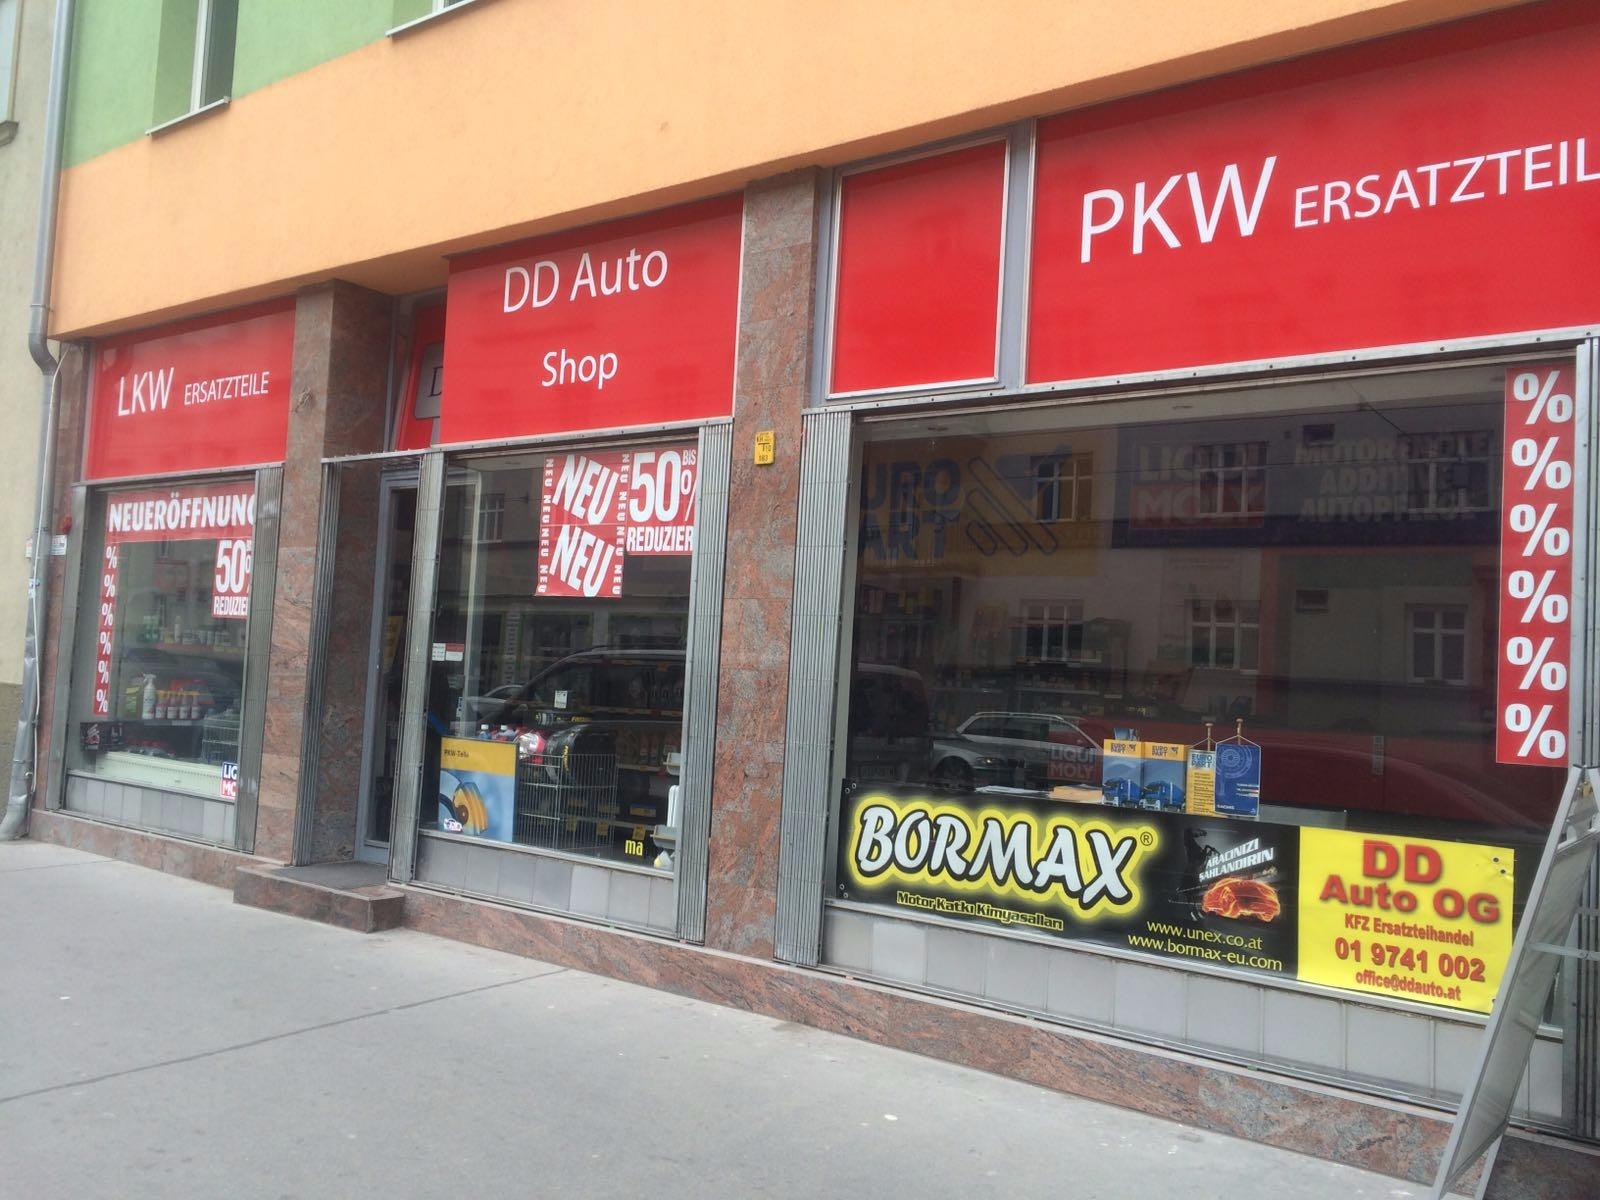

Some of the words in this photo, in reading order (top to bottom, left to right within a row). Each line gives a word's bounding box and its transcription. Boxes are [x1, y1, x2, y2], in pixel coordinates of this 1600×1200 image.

[1081, 156, 1277, 264] PKW
[1294, 137, 1600, 229] ERSATZTEIL
[503, 260, 560, 313] DD
[569, 247, 668, 301] Auto
[541, 348, 618, 390] Shop
[118, 367, 175, 417] LKW
[184, 371, 270, 406] ERSATZTEILE
[545, 459, 554, 487] NEU
[682, 449, 696, 466] BIS
[552, 455, 619, 525] NEU
[542, 495, 551, 523] NEU
[541, 528, 549, 557] NEU
[549, 524, 615, 597] NEU
[538, 565, 548, 593] NEU
[1050, 763, 1094, 778] MOLY
[1051, 747, 1095, 763] LIQUI
[1362, 840, 1443, 884] DD
[896, 891, 936, 908] Motor
[1320, 874, 1418, 912] Auto
[1433, 888, 1501, 924] OG
[1146, 921, 1263, 950] www.unex.co.at
[1345, 913, 1370, 931] KFZ
[1128, 935, 1283, 971] www.bormax-eu.com
[1335, 937, 1361, 962] 01
[1371, 943, 1428, 973] 9741
[1439, 953, 1486, 983] 002
[1356, 969, 1461, 1001] office@ddauto.at
